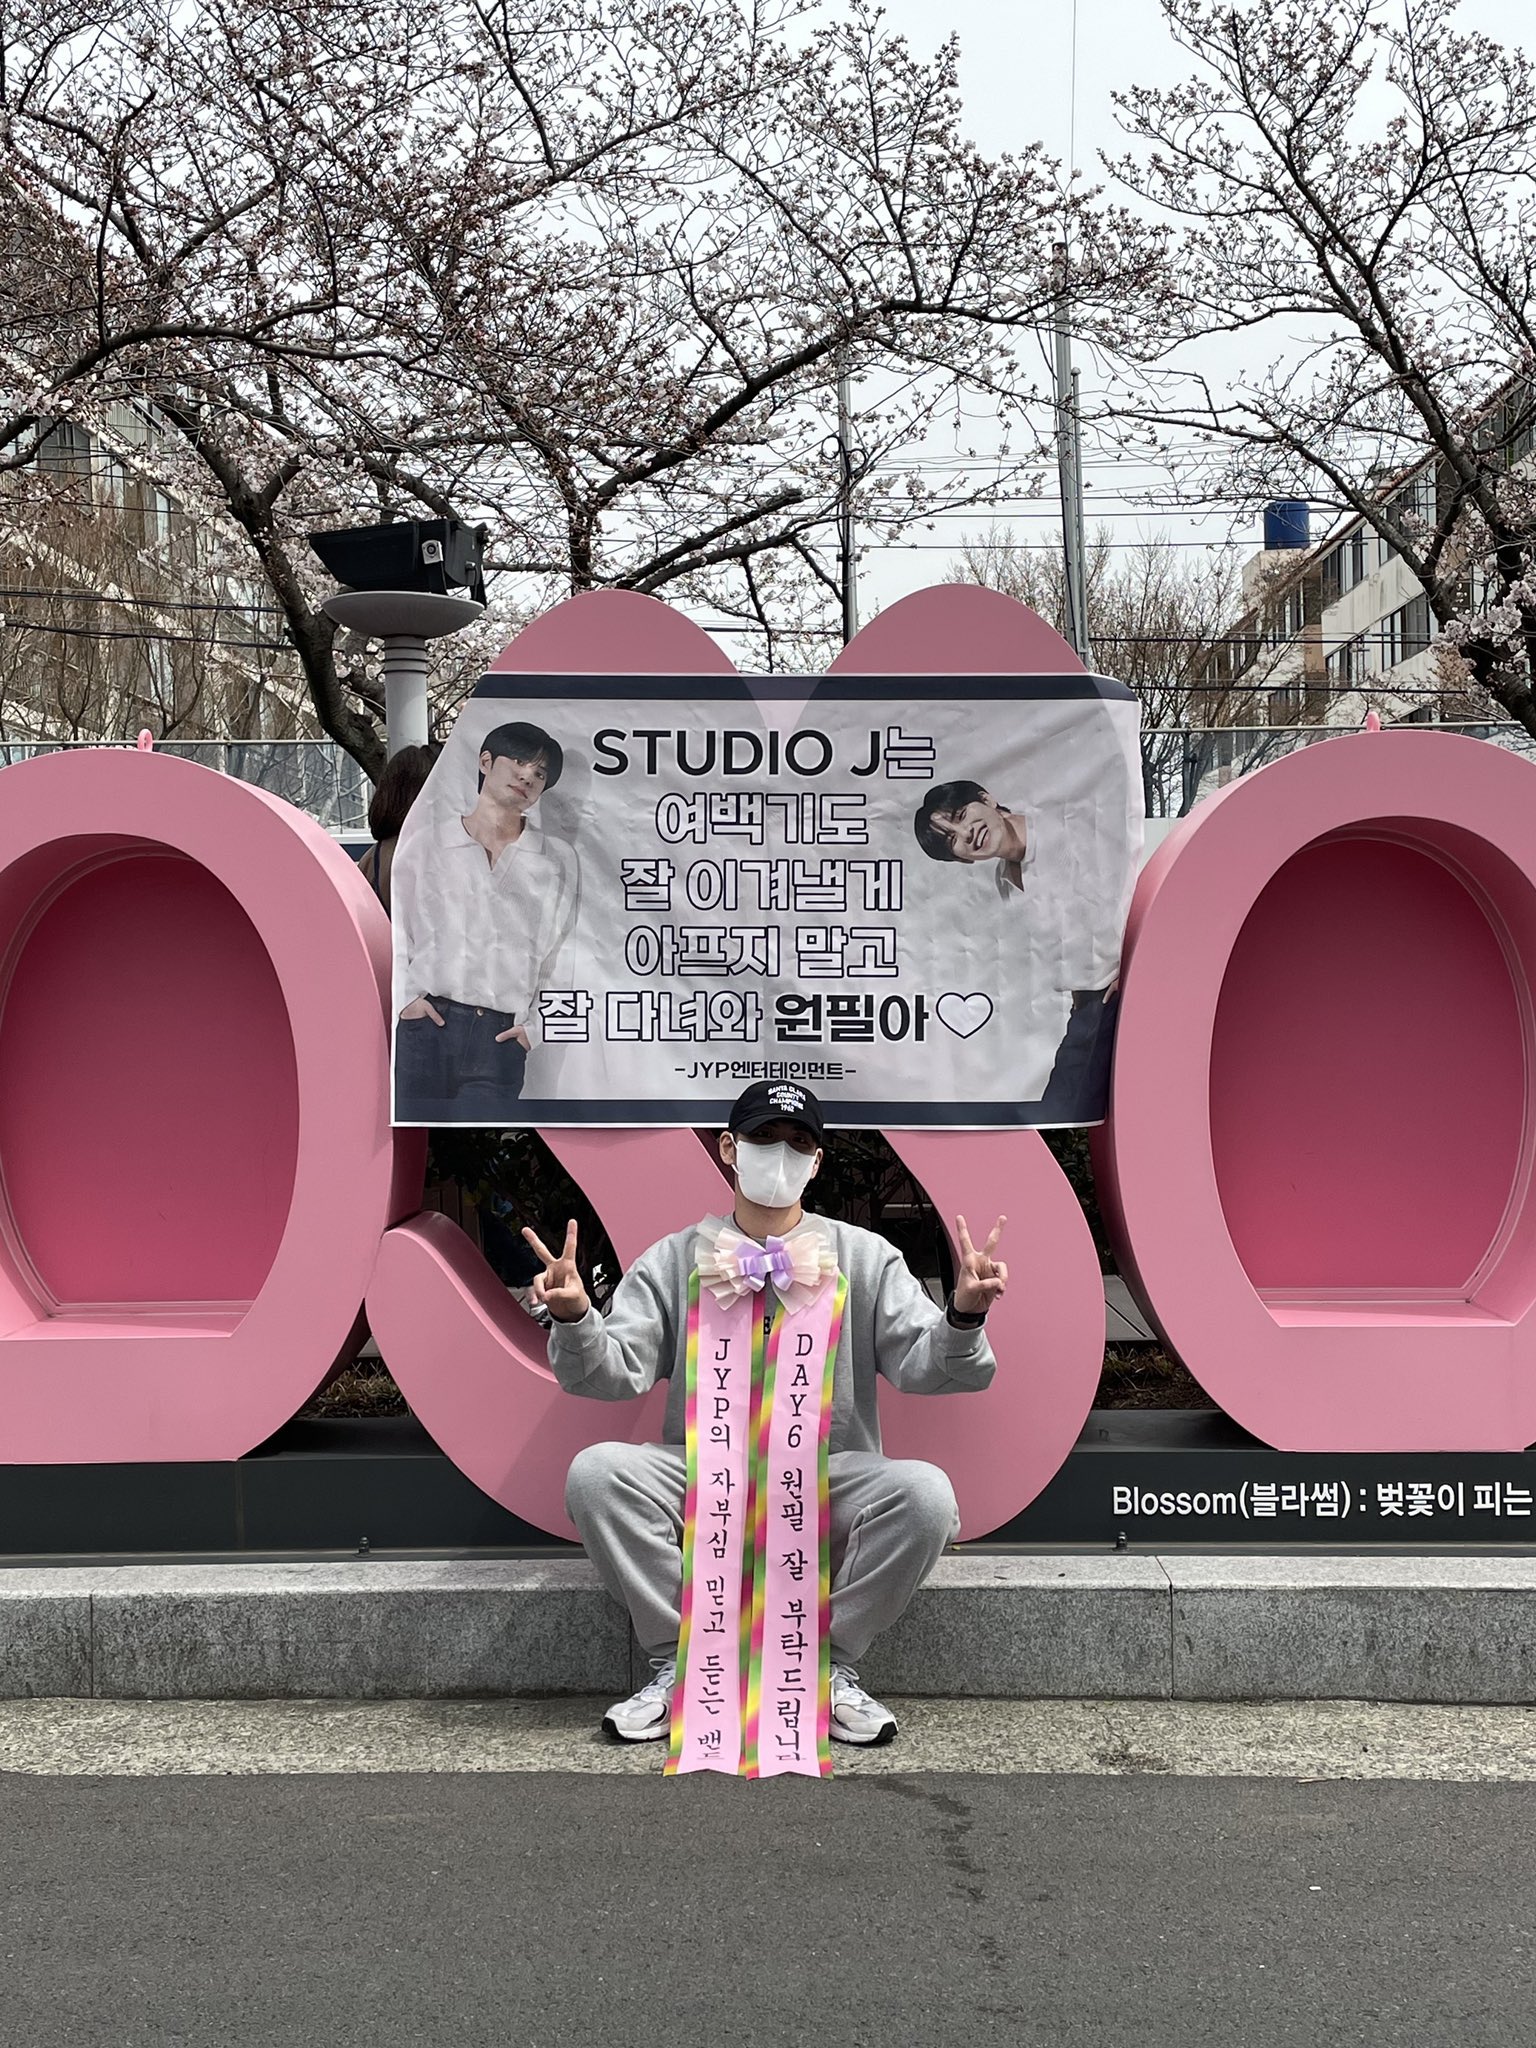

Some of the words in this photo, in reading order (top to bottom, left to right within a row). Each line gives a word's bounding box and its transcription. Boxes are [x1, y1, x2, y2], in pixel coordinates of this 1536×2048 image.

[592, 728, 833, 777] STUDIO
[849, 725, 937, 780] J는
[655, 791, 869, 846] 여백기도
[619, 858, 676, 912] 잘
[685, 858, 903, 913] 이겨낼게
[624, 924, 781, 978] 아프지
[795, 925, 899, 979] 말고
[537, 989, 594, 1043] 잘
[605, 990, 764, 1043] 다녀와
[774, 994, 930, 1043] 원필아
[674, 1061, 857, 1081] -JYP엔터테인먼트-
[767, 1084, 788, 1096] SANTA
[788, 1085, 806, 1102] CLARA
[776, 1091, 799, 1101] COUNTY
[780, 1103, 795, 1113] 1962
[709, 1337, 732, 1452] JYP의
[786, 1333, 814, 1449] DAY6
[706, 1467, 736, 1560] 자부심
[779, 1467, 804, 1532] 원필
[1112, 1480, 1352, 1519] Blossom(블라썸)
[1376, 1481, 1465, 1517] 벚꽃이
[1472, 1481, 1534, 1517] 피는
[779, 1548, 809, 1582] 잘
[702, 1575, 726, 1634] 믿고
[697, 1654, 726, 1716] 듣는
